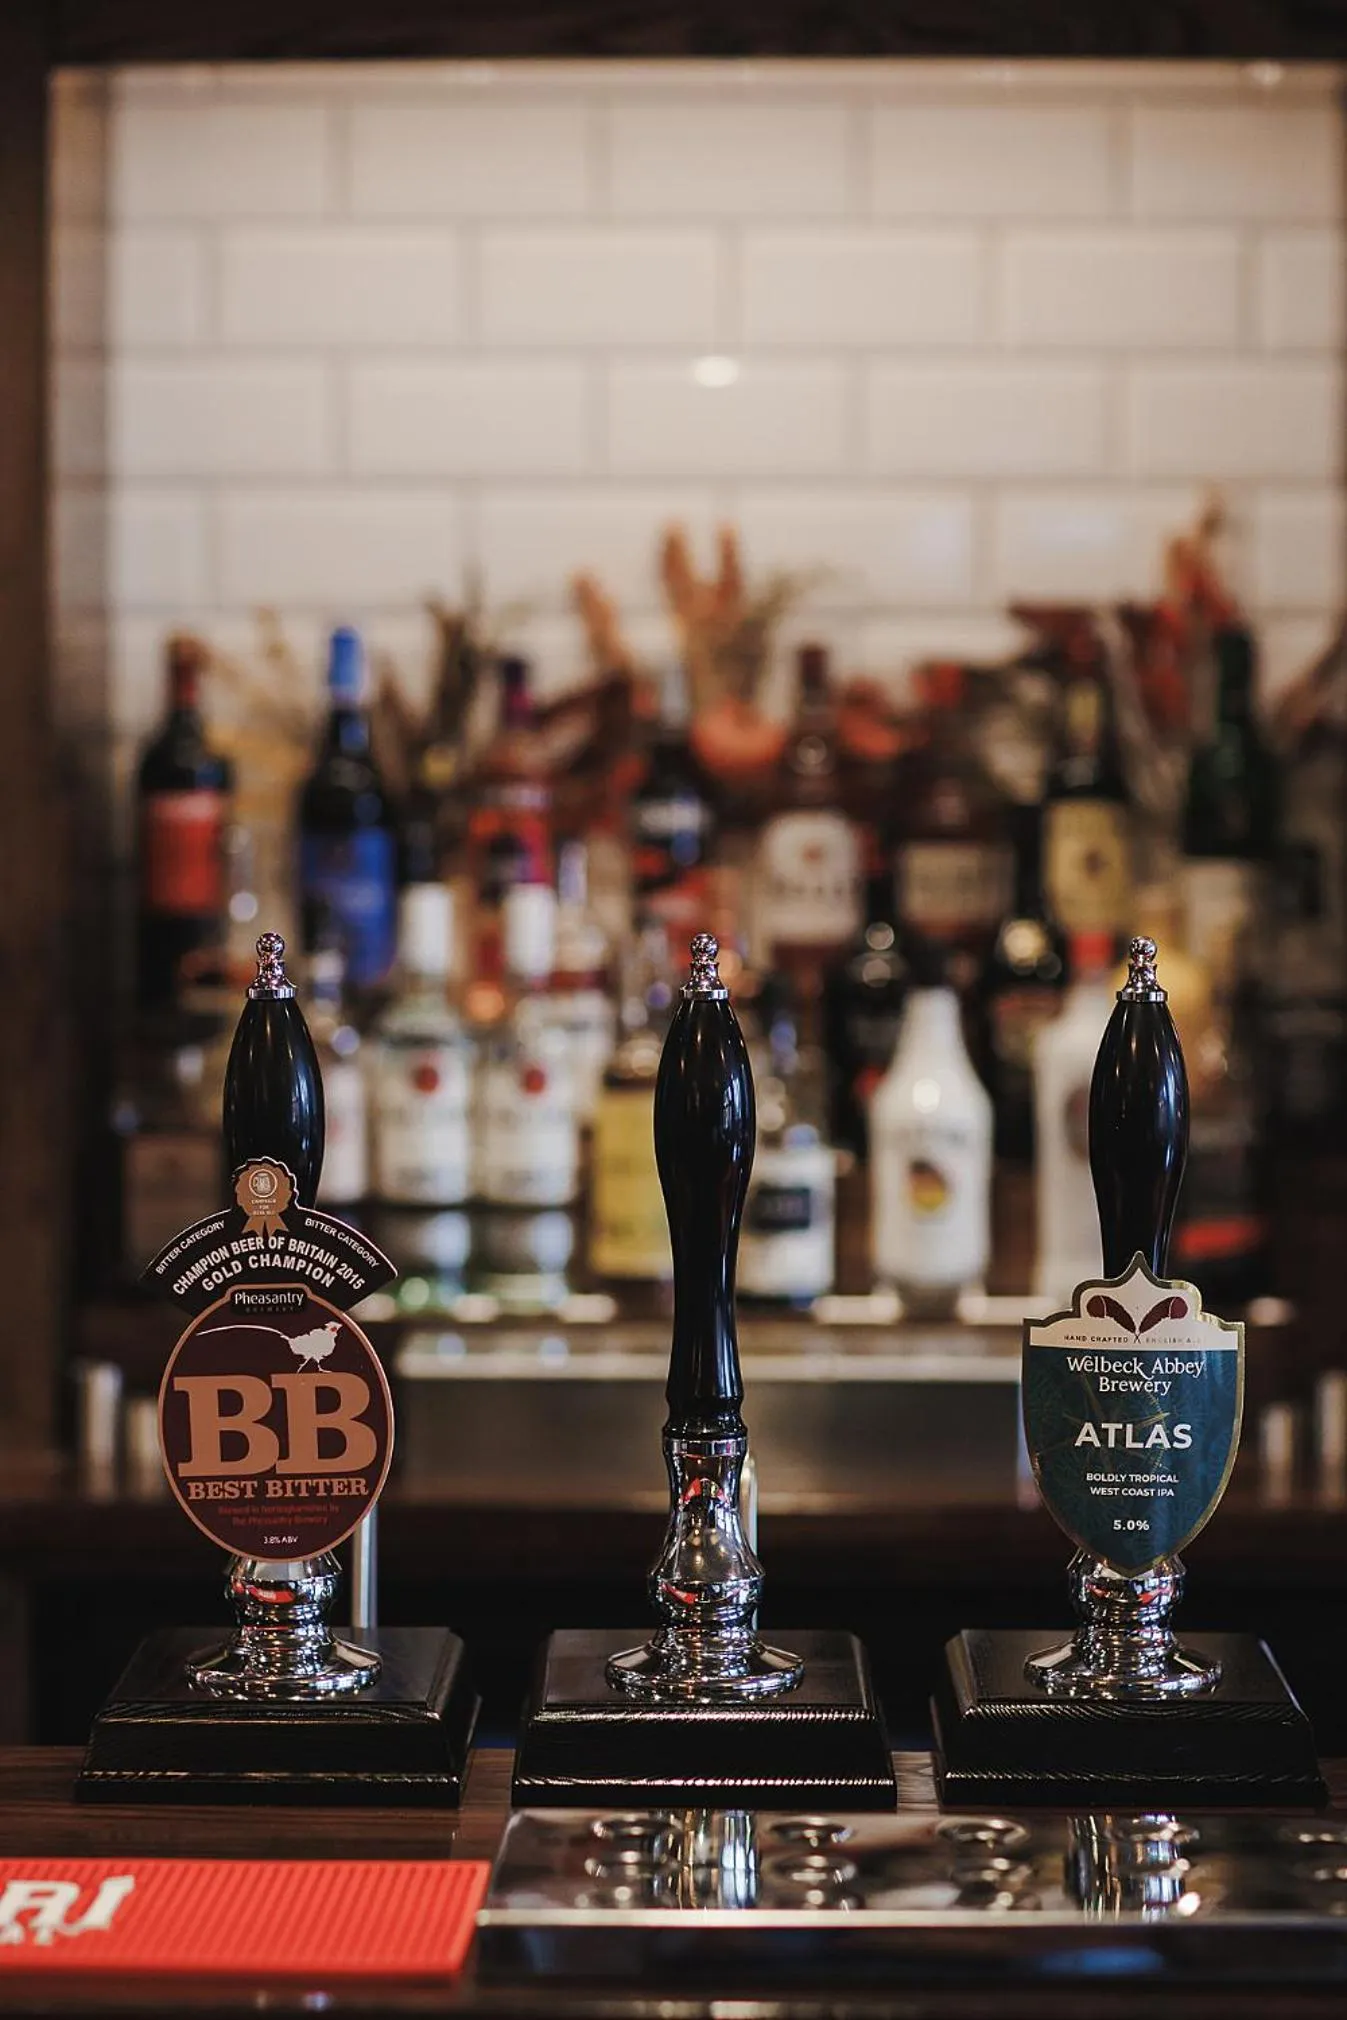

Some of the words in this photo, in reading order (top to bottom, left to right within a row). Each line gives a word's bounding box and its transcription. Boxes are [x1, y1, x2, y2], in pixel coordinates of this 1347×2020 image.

[155, 1247, 182, 1275] BITTER
[180, 1220, 225, 1249] CATEGORY
[304, 1218, 338, 1237] BITTER
[337, 1232, 379, 1268] CATEGORY
[172, 1245, 230, 1295] CHAMPION
[230, 1236, 265, 1255] BEER
[268, 1236, 285, 1250] OF
[288, 1238, 339, 1269] BRITAIN
[336, 1262, 366, 1290] 2015
[201, 1260, 243, 1292] GOLD
[248, 1253, 336, 1288] CHAMPION
[234, 1291, 304, 1306] Pheasantry
[1063, 1334, 1088, 1342] HAND
[1090, 1335, 1129, 1343] CRAFTED
[1066, 1355, 1155, 1380] Welbeck
[1151, 1357, 1207, 1379] Abbey
[1099, 1376, 1172, 1396] Brewery
[173, 1372, 378, 1477] BB
[1074, 1421, 1193, 1449] ATLAS
[1086, 1472, 1127, 1482] BOLDLY
[1128, 1474, 1180, 1483] TROPICAL
[186, 1480, 259, 1500] BEST
[265, 1478, 369, 1497] BITTER
[1089, 1486, 1120, 1496] WEST
[1121, 1487, 1156, 1497] COAST
[1157, 1488, 1175, 1497] IPA
[1113, 1519, 1150, 1531] 5.0%
[282, 1535, 299, 1544] ABV
